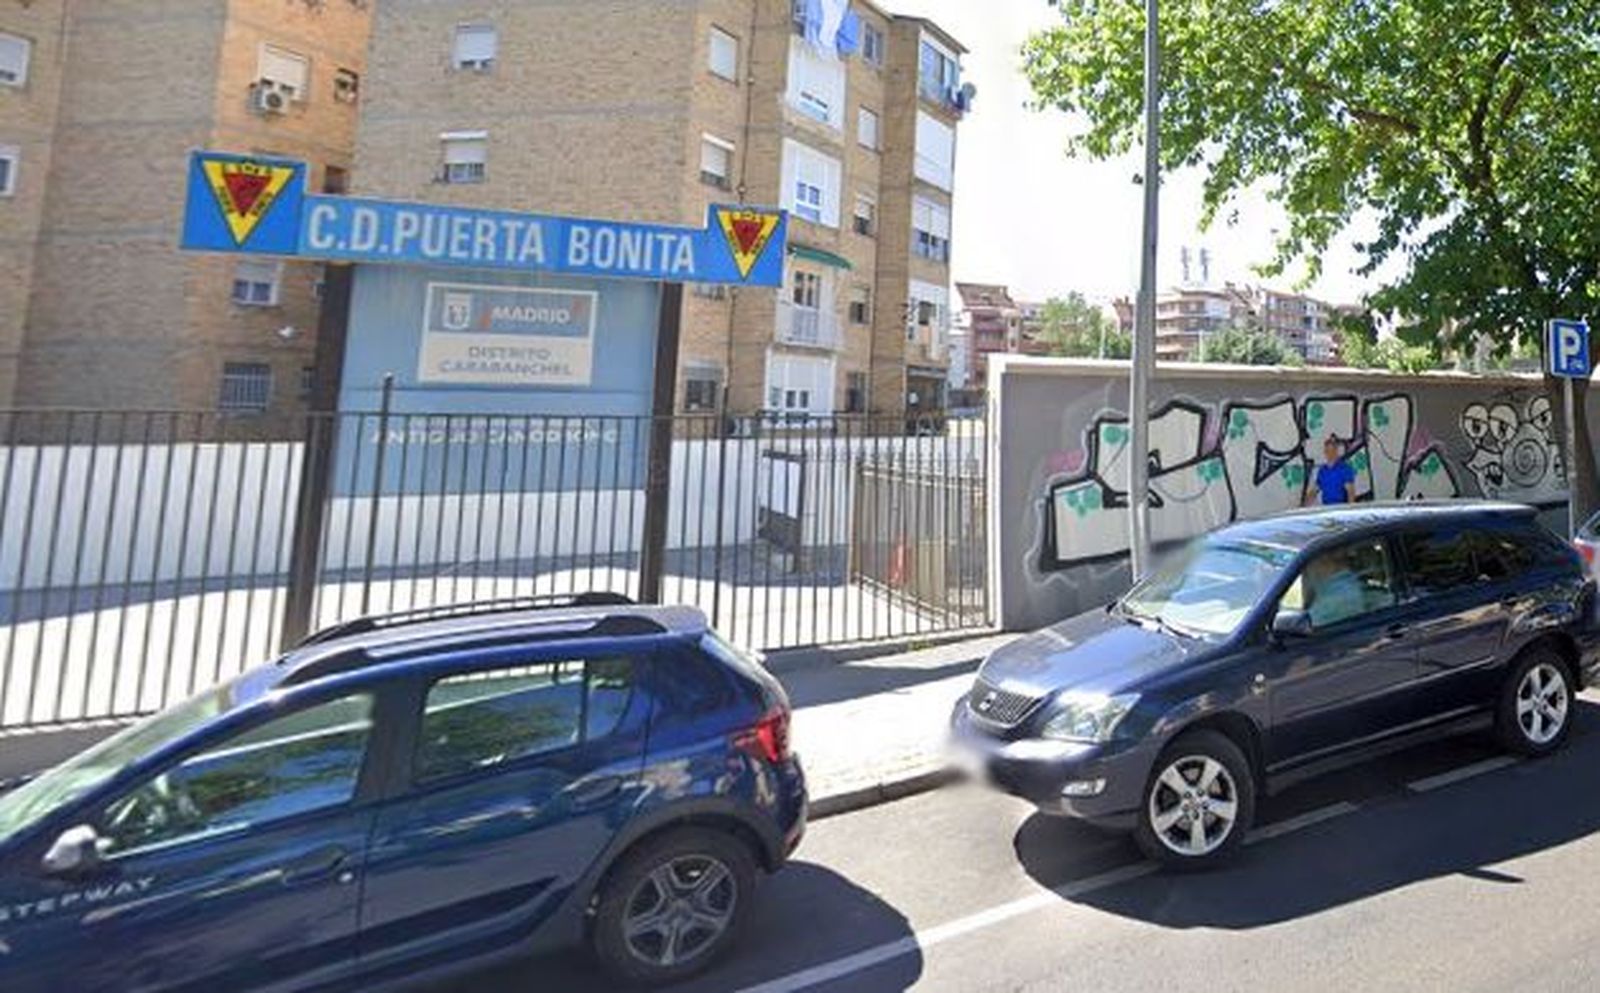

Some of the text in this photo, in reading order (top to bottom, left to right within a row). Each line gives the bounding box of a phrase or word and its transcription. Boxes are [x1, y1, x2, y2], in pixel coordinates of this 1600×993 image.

[567, 225, 695, 274] BONITA
[467, 345, 552, 361] DISTRITO
[1559, 326, 1581, 370] P
[438, 360, 573, 376] CARABANCHEL
